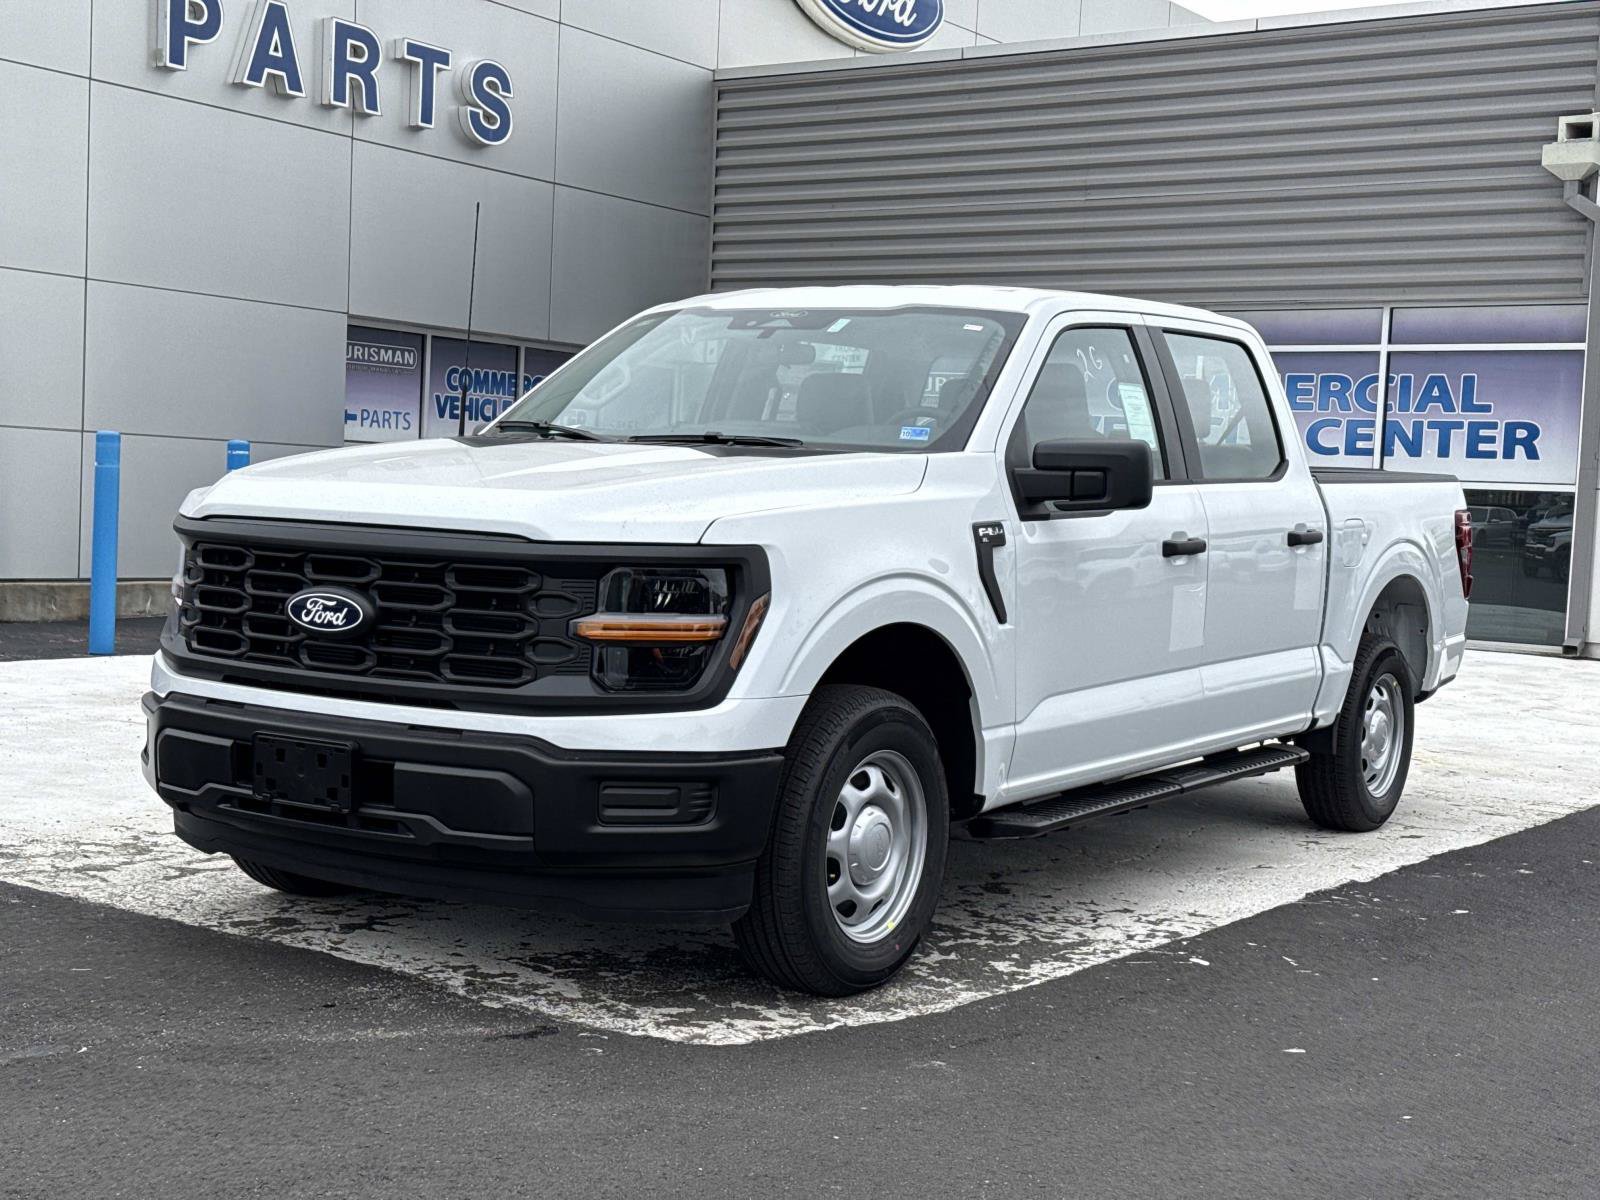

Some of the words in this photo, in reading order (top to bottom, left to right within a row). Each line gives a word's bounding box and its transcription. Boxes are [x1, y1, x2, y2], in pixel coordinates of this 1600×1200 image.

[158, 0, 514, 145] PARTS
[1281, 374, 1493, 414] ERCIAL
[360, 408, 412, 431] PARTS
[1305, 417, 1541, 461] CENTER
[301, 597, 348, 626] Ford
